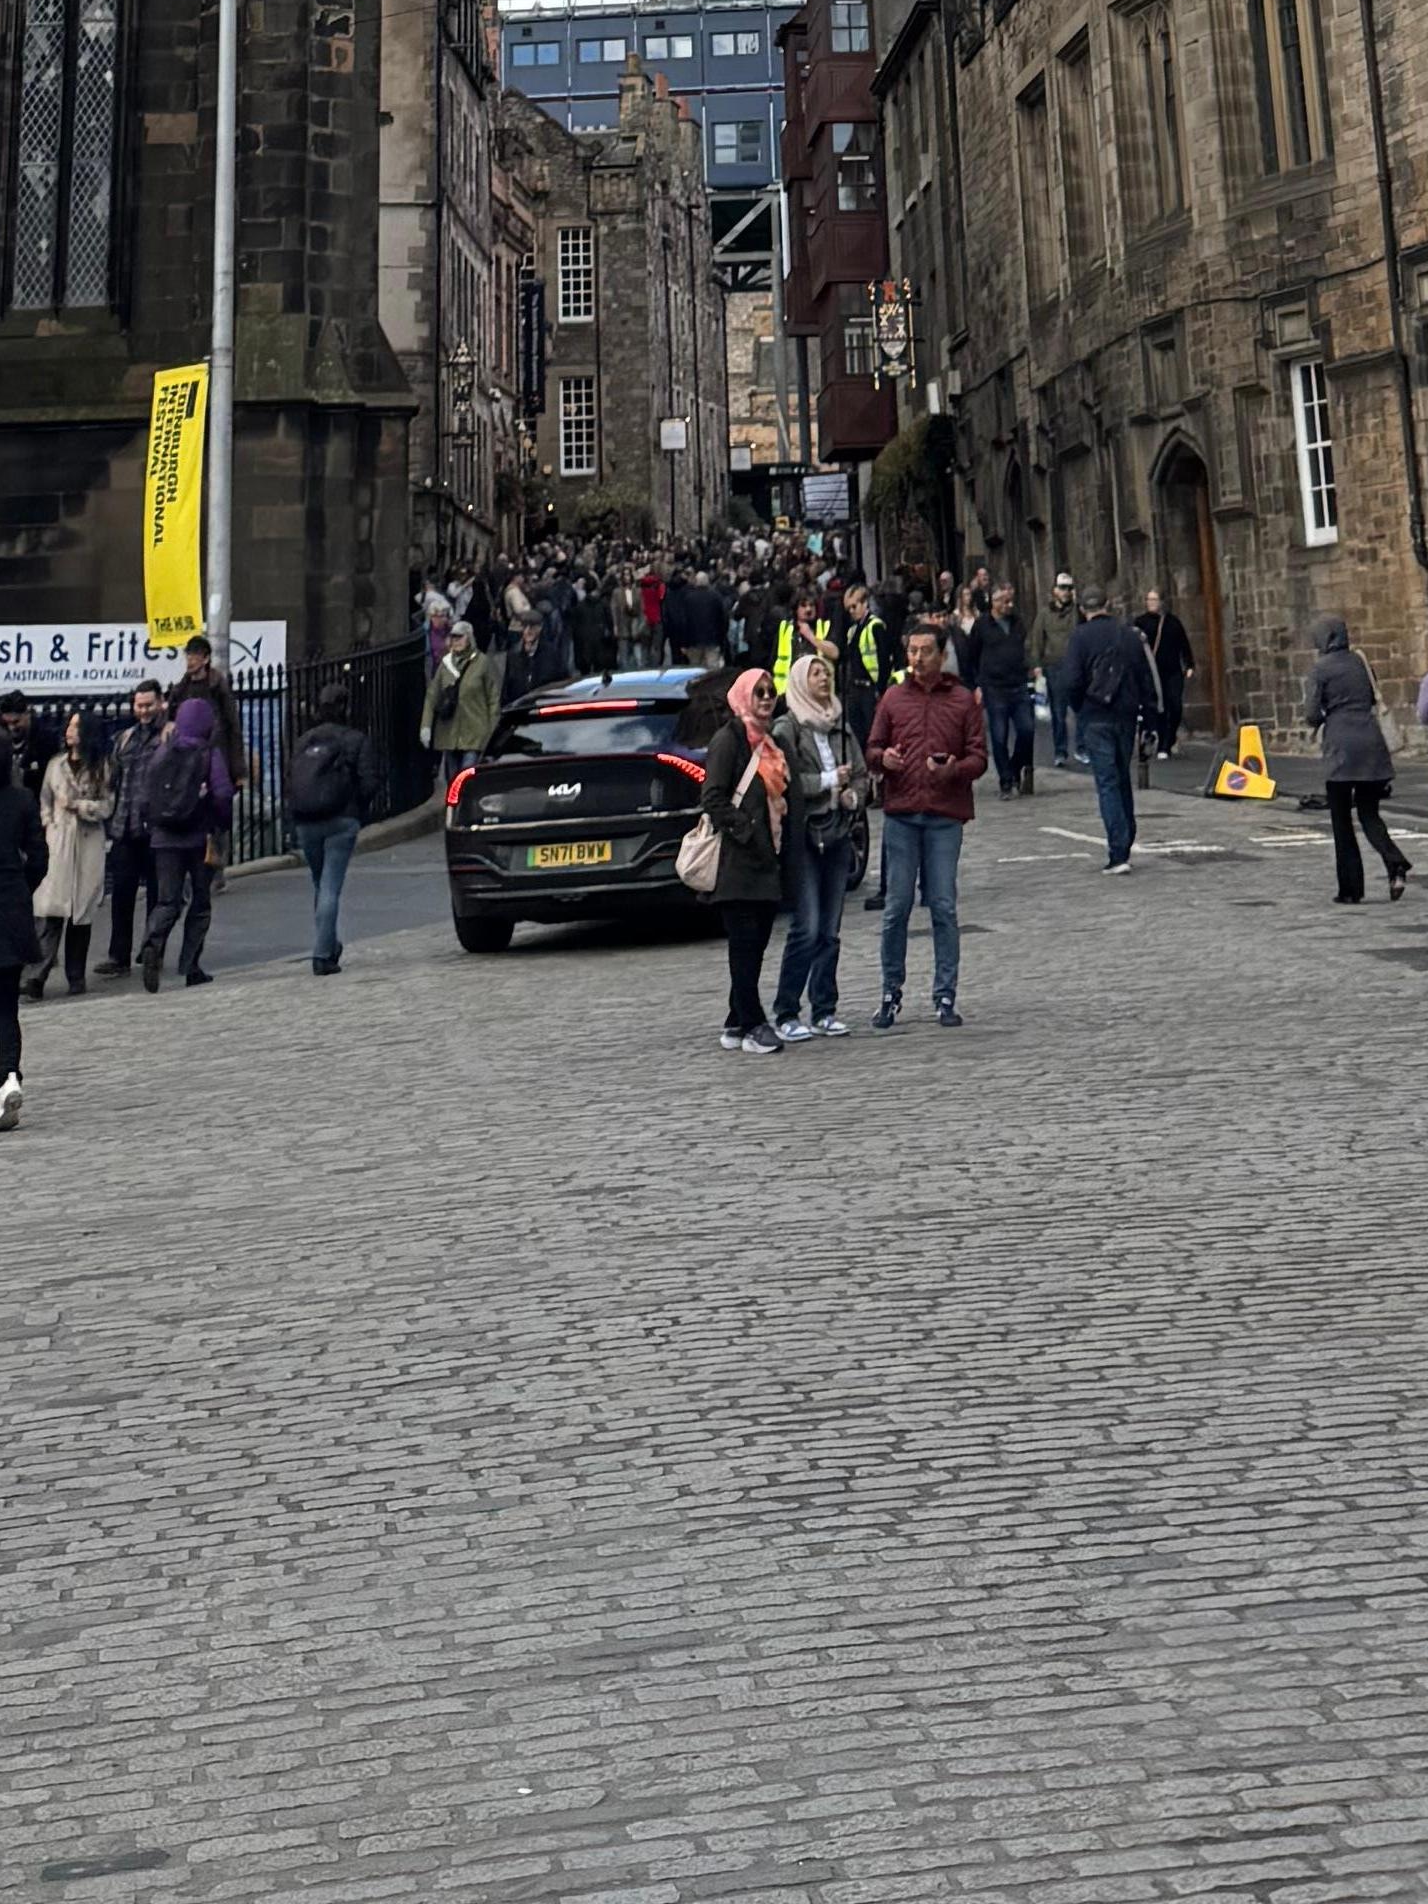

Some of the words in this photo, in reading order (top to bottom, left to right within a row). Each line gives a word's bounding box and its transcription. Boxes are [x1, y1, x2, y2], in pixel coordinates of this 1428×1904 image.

[49, 633, 70, 663] &
[87, 630, 179, 662] Frites
[3, 669, 71, 681] ANSTRUTHER
[82, 668, 119, 680] ROYAL
[122, 667, 146, 679] MILE
[540, 844, 573, 862] SN71
